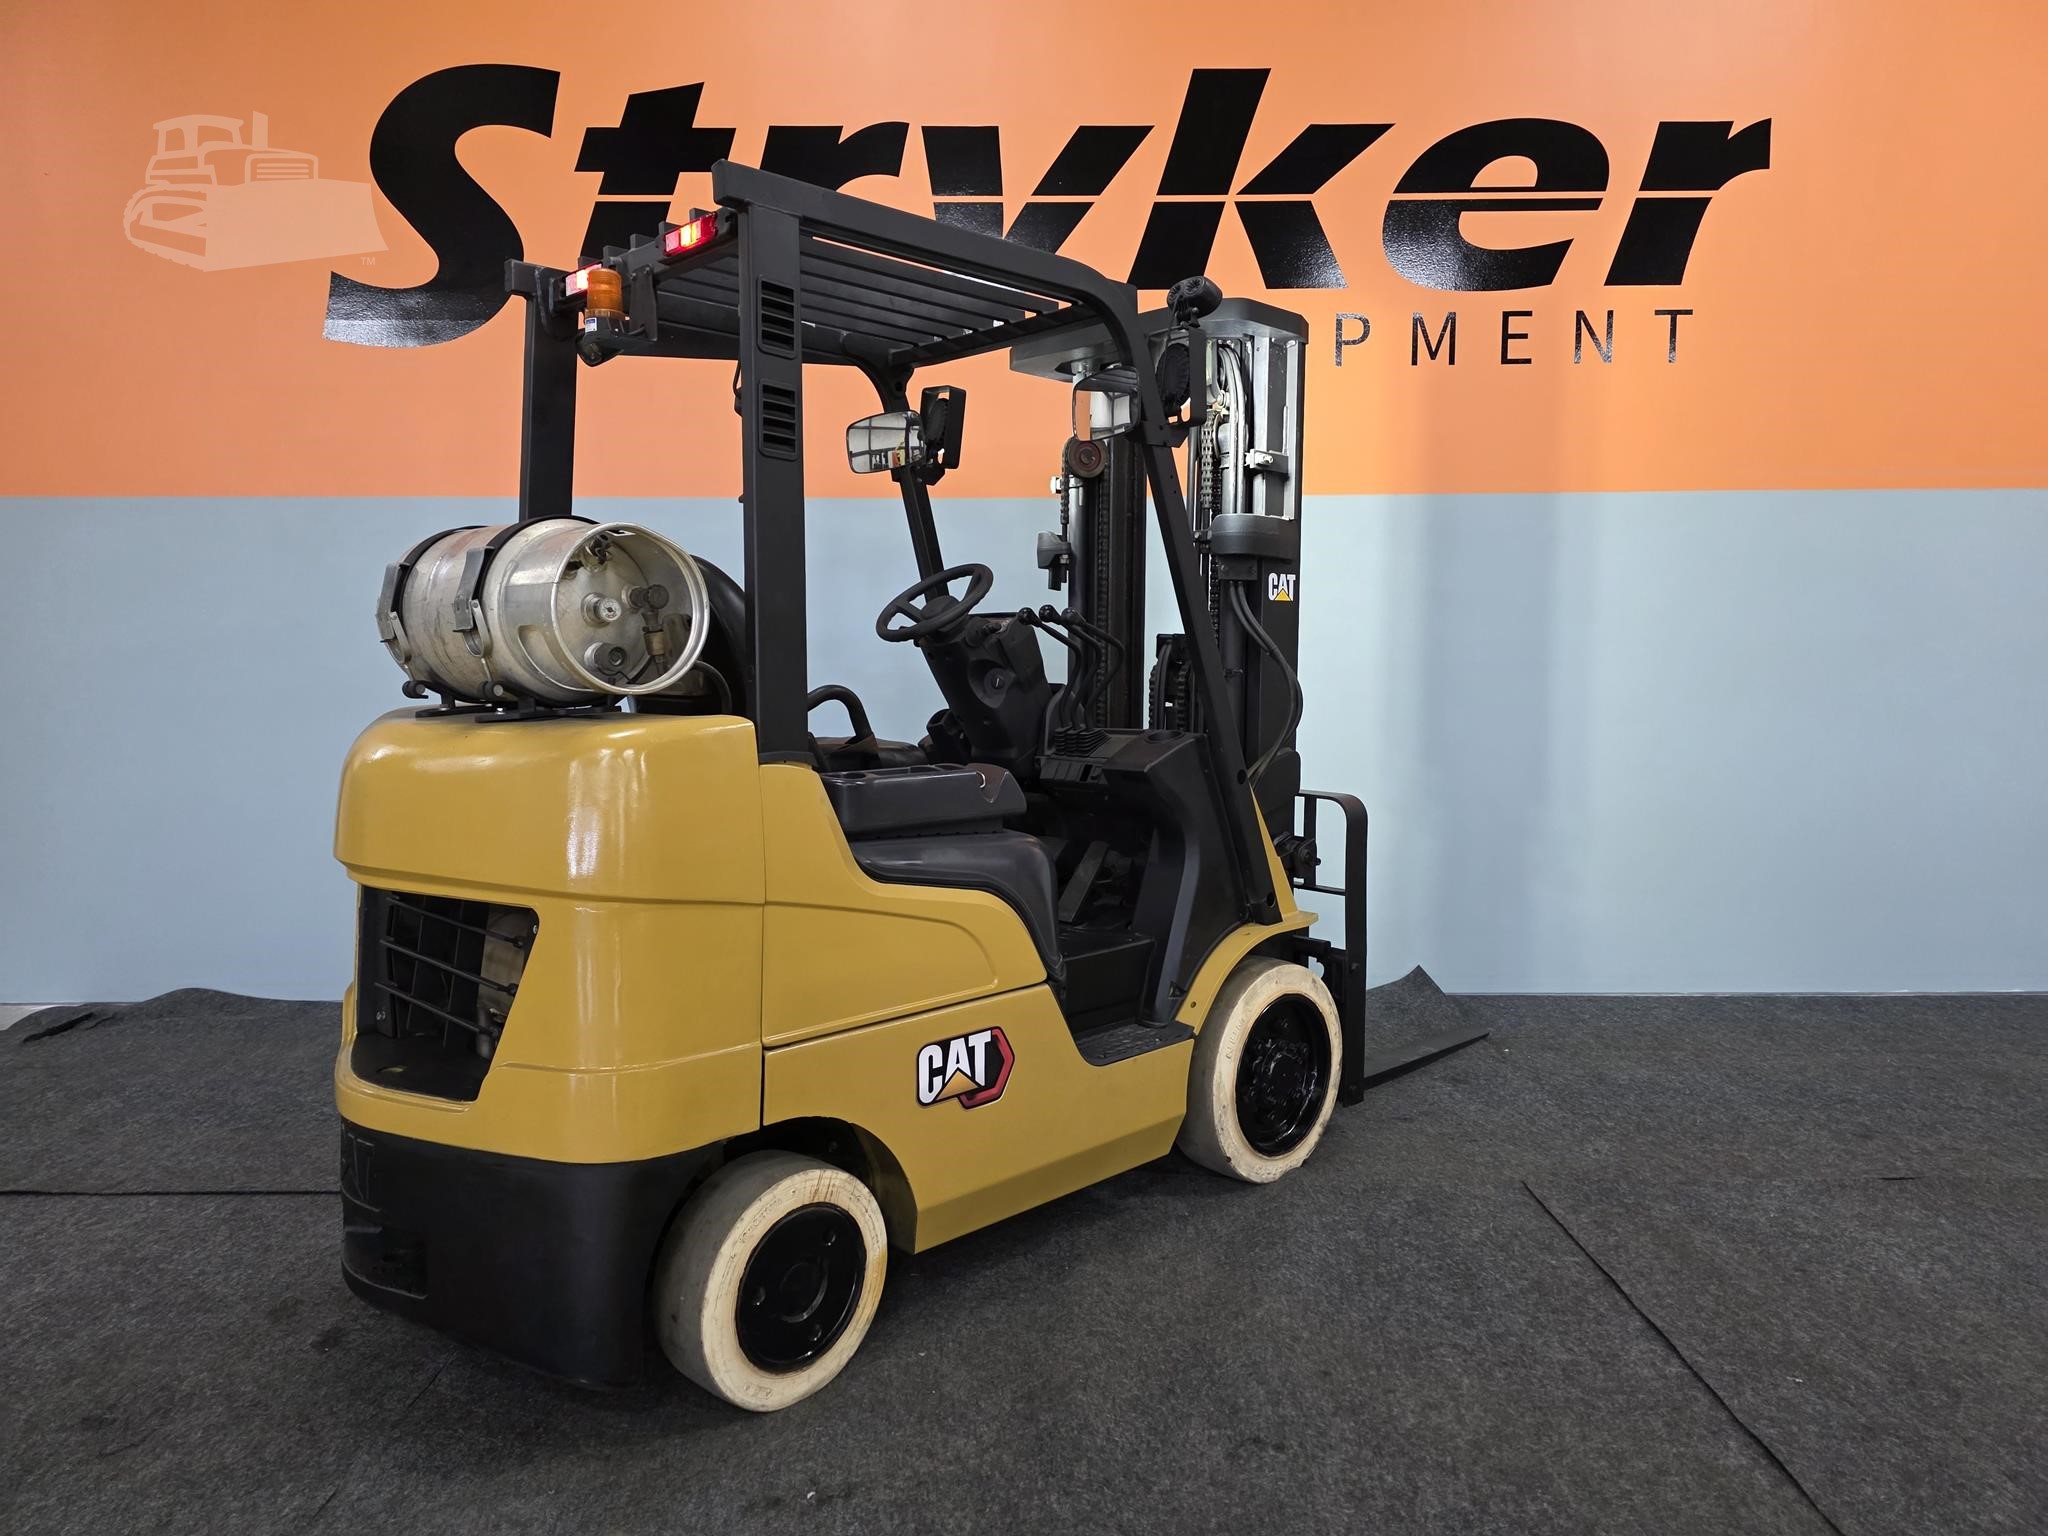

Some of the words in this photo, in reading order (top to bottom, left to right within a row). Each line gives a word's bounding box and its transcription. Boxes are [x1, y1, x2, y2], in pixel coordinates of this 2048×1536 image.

[1333, 309, 1694, 366] PMENT
[1268, 572, 1296, 602] CAT
[918, 1029, 992, 1104] CAT
